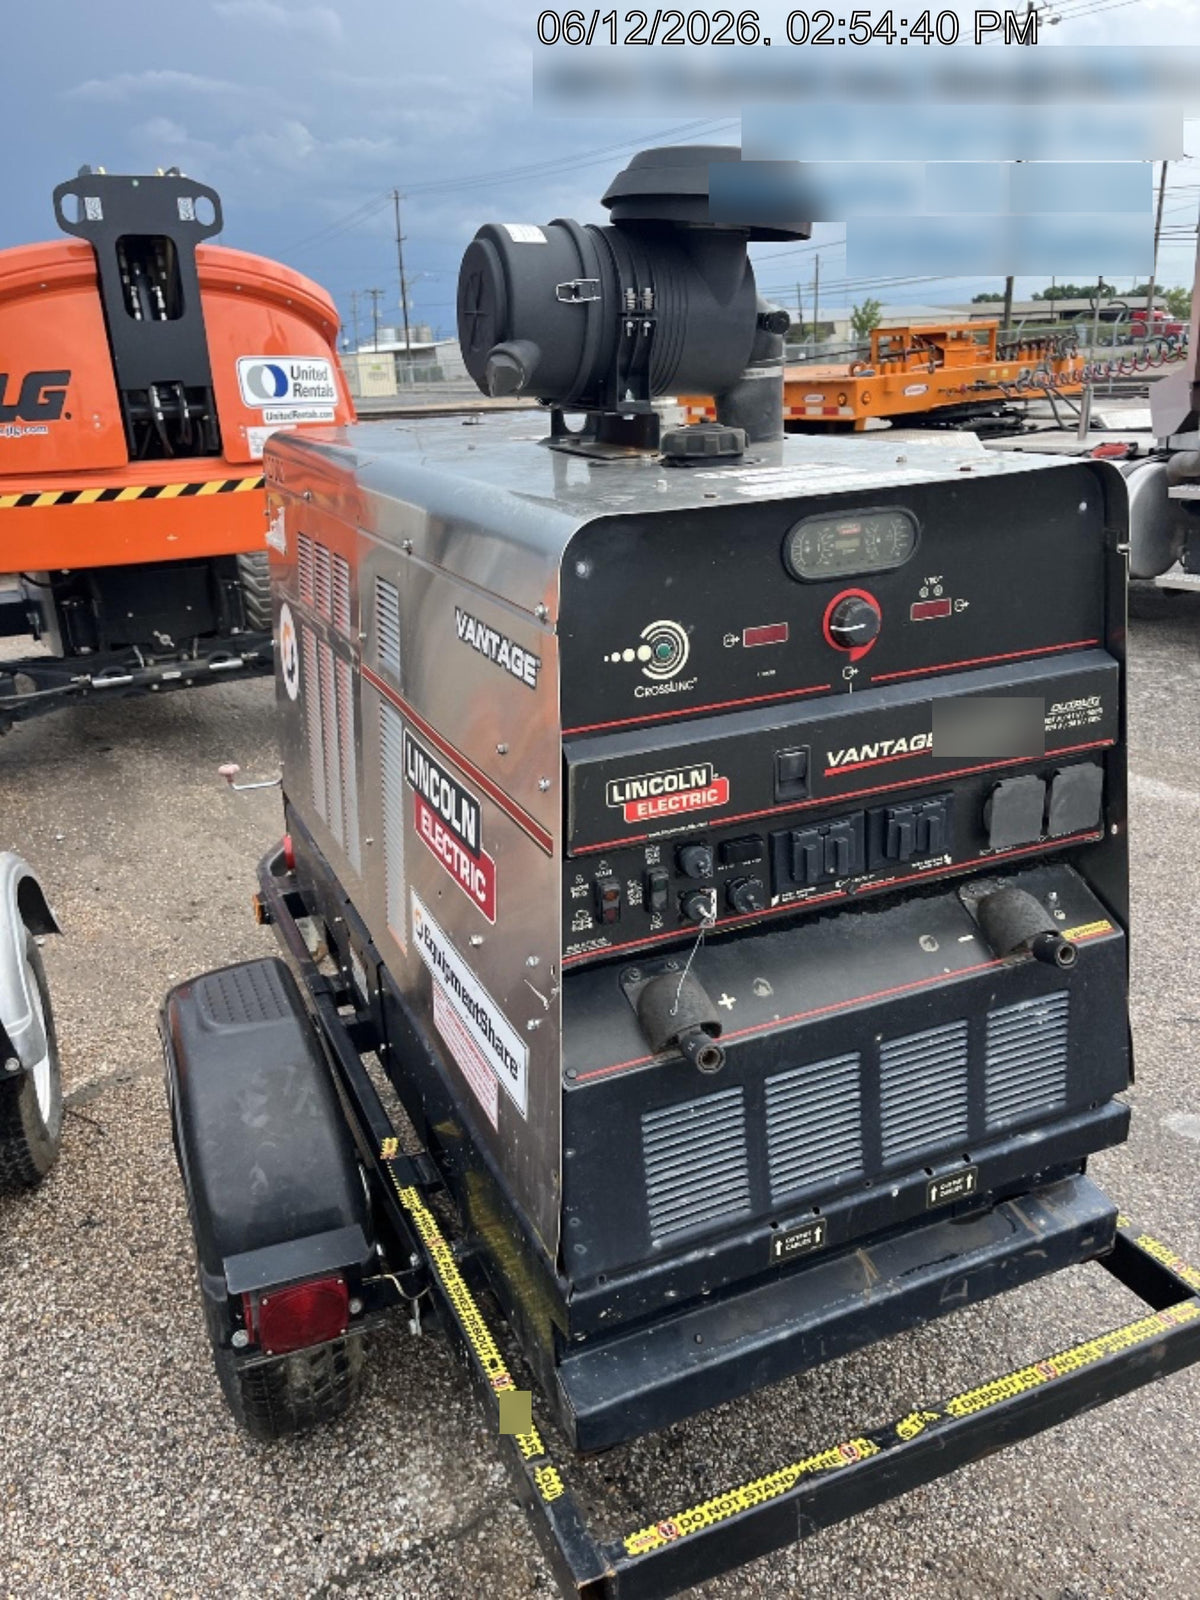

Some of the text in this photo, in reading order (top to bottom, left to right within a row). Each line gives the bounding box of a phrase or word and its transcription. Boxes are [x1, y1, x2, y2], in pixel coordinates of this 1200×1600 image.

[290, 365, 328, 381] United
[293, 383, 335, 398] Rentals
[455, 608, 538, 688] VANTAGE
[406, 740, 476, 849] LINCOLN
[612, 768, 708, 802] LINCOLN
[637, 788, 719, 816] ELECTRIC
[420, 804, 487, 903] ELECTRIC
[423, 924, 519, 1081] EquipmentShare
[1076, 1348, 1096, 1361] SE
[961, 1378, 1018, 1408] DEBOUT
[1020, 1371, 1040, 1387] ICI
[679, 1511, 705, 1529] DO
[707, 1496, 742, 1518] NOT
[743, 1471, 797, 1500] STAND
